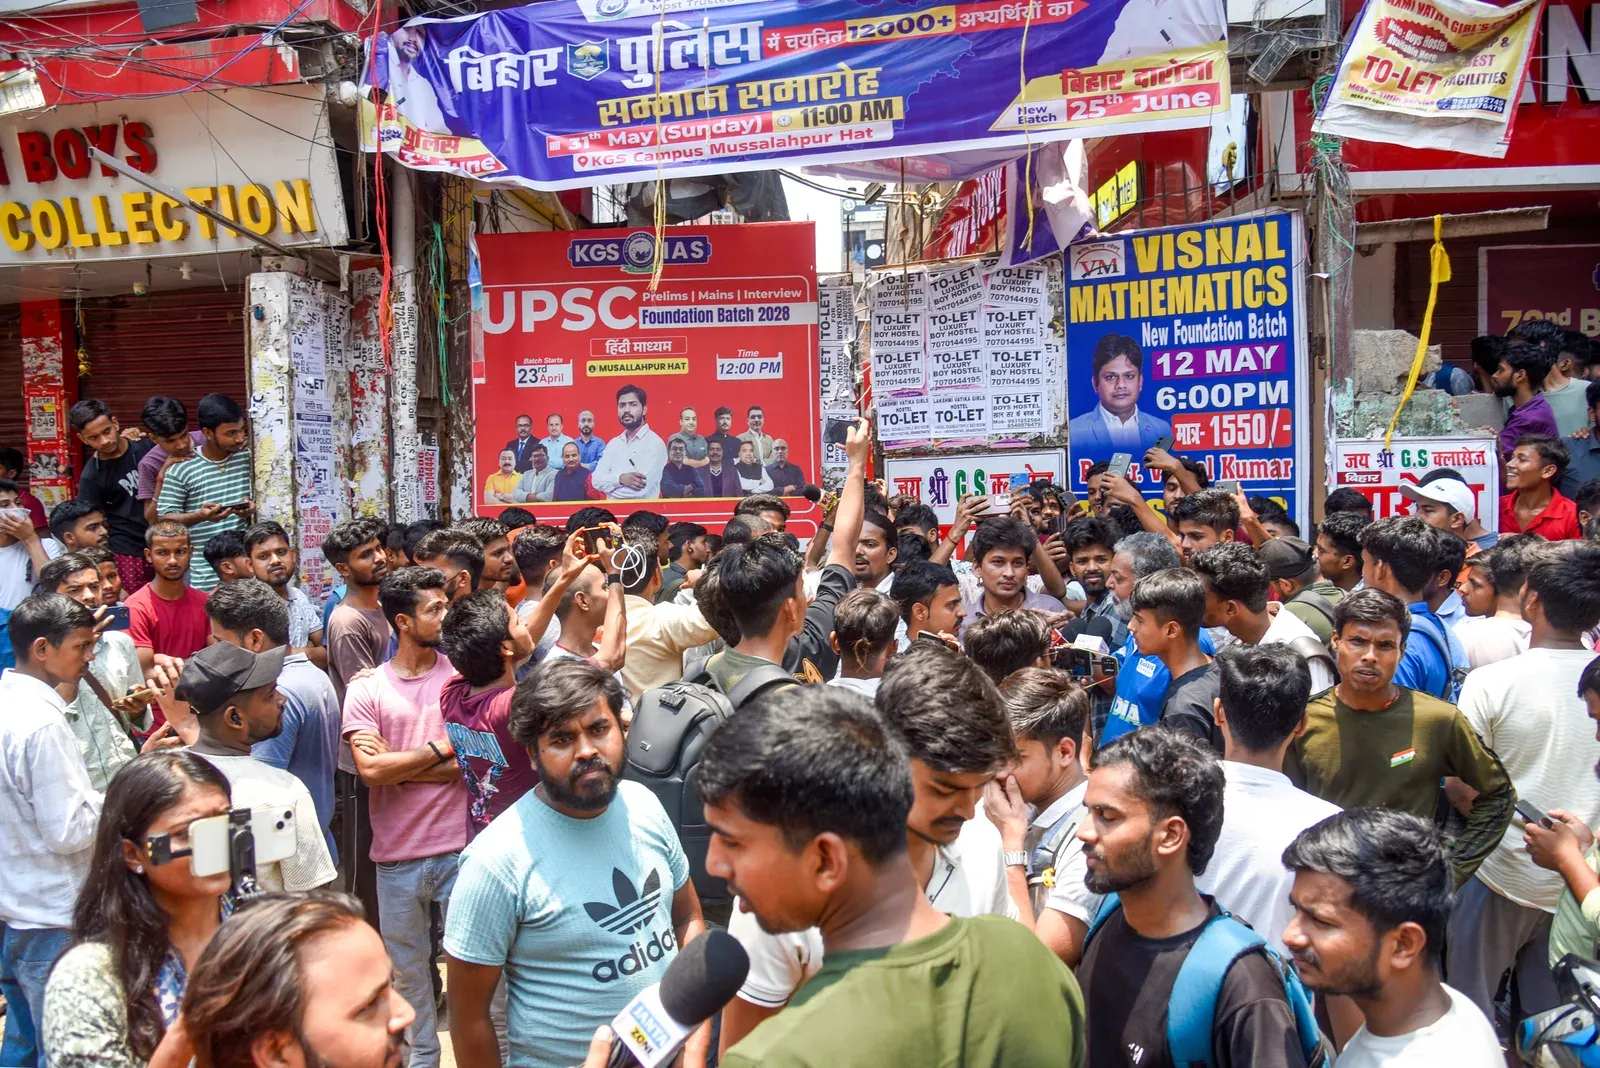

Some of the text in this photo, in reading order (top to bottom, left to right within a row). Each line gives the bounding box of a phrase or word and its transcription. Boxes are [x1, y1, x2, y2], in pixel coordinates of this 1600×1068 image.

[652, 2, 682, 11] Most
[1404, 29, 1422, 46] Boys
[443, 46, 563, 94] बिहार
[616, 20, 764, 89] पुलिस
[766, 29, 779, 51] में
[784, 28, 844, 50] चयनित
[848, 14, 953, 39] 12000+
[1047, 0, 1074, 17] का
[1418, 47, 1438, 61] Here
[1060, 58, 1214, 95] बिहार दारोगा
[1362, 55, 1443, 96] TO-LET
[597, 62, 882, 126] सम्मान समारोह
[1018, 105, 1048, 116] New
[1069, 91, 1211, 120] 25th June
[568, 99, 894, 151] 31th May (Sunday) 11:00 AM
[1018, 113, 1057, 125] Batch
[401, 125, 461, 154] पुलिस
[592, 127, 873, 167] KGS Campus Mussalahpur Hat
[0, 178, 317, 252] COLLECTION
[575, 241, 705, 263] KGS IAS
[1133, 220, 1286, 274] VISHAL
[930, 266, 976, 291] TO-LET
[996, 268, 1043, 280] TO-LET
[642, 288, 802, 302] Prelims Mains Interview
[933, 283, 982, 305] BOY HOSTEL
[941, 280, 969, 295] LUXURY
[1009, 285, 1041, 294] HOSTEL
[1070, 265, 1288, 324] MATHEMATICS
[879, 298, 923, 307] 707014195
[483, 286, 638, 335] UPSC
[642, 305, 790, 325] Foundation Batch 2028
[820, 291, 830, 340] TO-LET
[930, 310, 976, 326] TO-LET
[986, 310, 1036, 322] TO-LET
[876, 314, 920, 325] TO-LET
[939, 322, 968, 331] LUXURY
[947, 328, 979, 337] HOSTEL
[1142, 310, 1287, 348] New Foundation Batch
[605, 338, 672, 356] हिंदी माध्यम
[737, 349, 759, 358] Time
[543, 356, 563, 364] Starts
[875, 351, 920, 364] TO-LET
[934, 349, 980, 363] TO-LET
[992, 350, 1041, 362] TO-LET
[1156, 345, 1280, 378] 12 MAY
[599, 361, 687, 373] MUSALLAHPUR HAT
[718, 361, 781, 376] 12:00 PM
[820, 348, 830, 396] TO-LET
[884, 362, 912, 370] LUXURY
[892, 368, 922, 376] HOSTEL
[942, 361, 971, 370] LUXURY
[950, 366, 982, 375] HOSTEL
[517, 365, 547, 385] 23rd
[540, 373, 564, 386] April
[994, 394, 1040, 405] TO-LET
[1156, 379, 1289, 411] 6:00PM
[881, 411, 928, 426] TO-LET
[935, 408, 984, 423] TO-LET
[1209, 407, 1291, 449] 1550/-
[1343, 446, 1487, 469] जय श्री G.S क्लासेज
[1220, 454, 1293, 481] Kumar
[1344, 472, 1380, 483] बिहार
[929, 467, 949, 507] श्री
